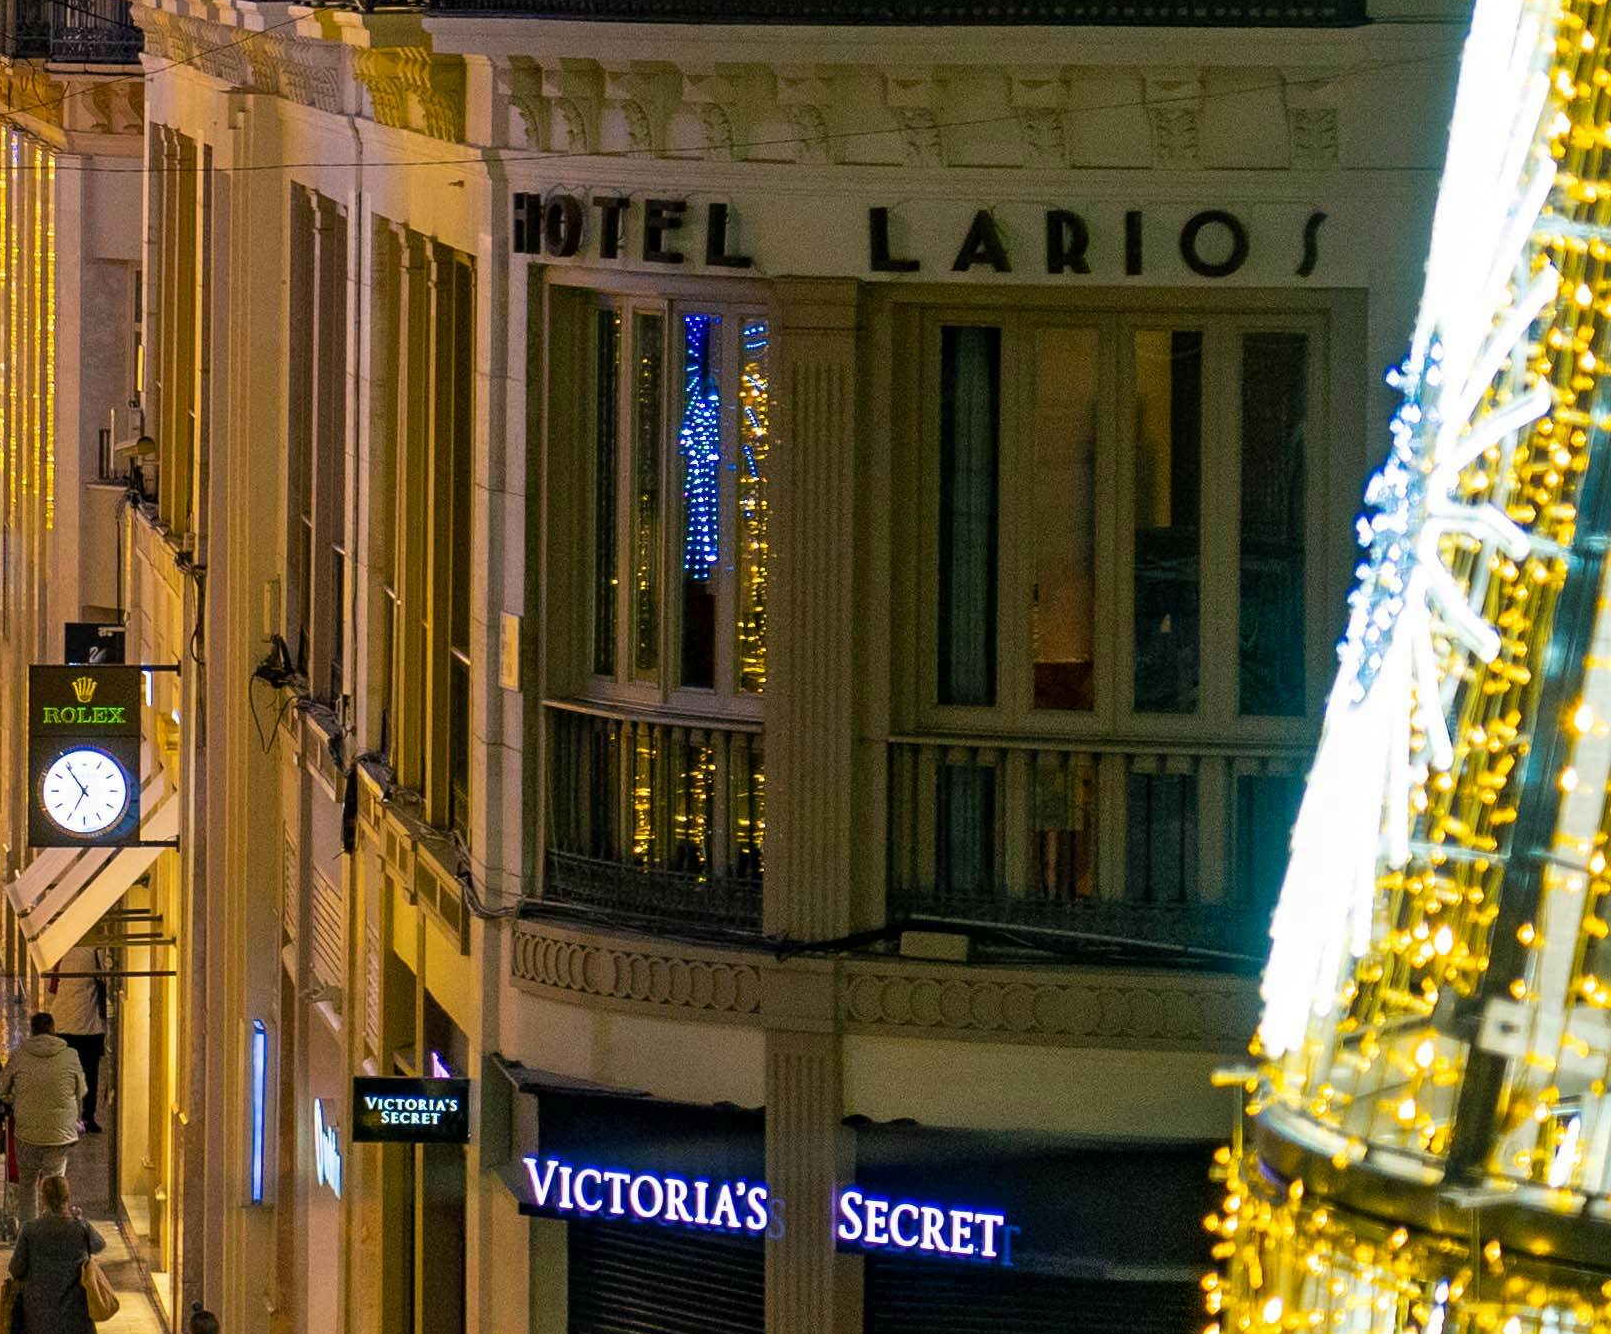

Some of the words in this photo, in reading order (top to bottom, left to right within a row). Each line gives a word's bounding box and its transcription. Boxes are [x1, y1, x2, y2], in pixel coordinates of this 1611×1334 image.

[513, 192, 754, 269] HOTEL
[869, 206, 1328, 278] LARIOS
[42, 707, 127, 724] ROLEX
[364, 1096, 459, 1112] VICTORIA'S
[380, 1112, 441, 1125] SECRET
[522, 1157, 768, 1231] VICTORIA'S
[837, 1190, 1005, 1258] SECRET
